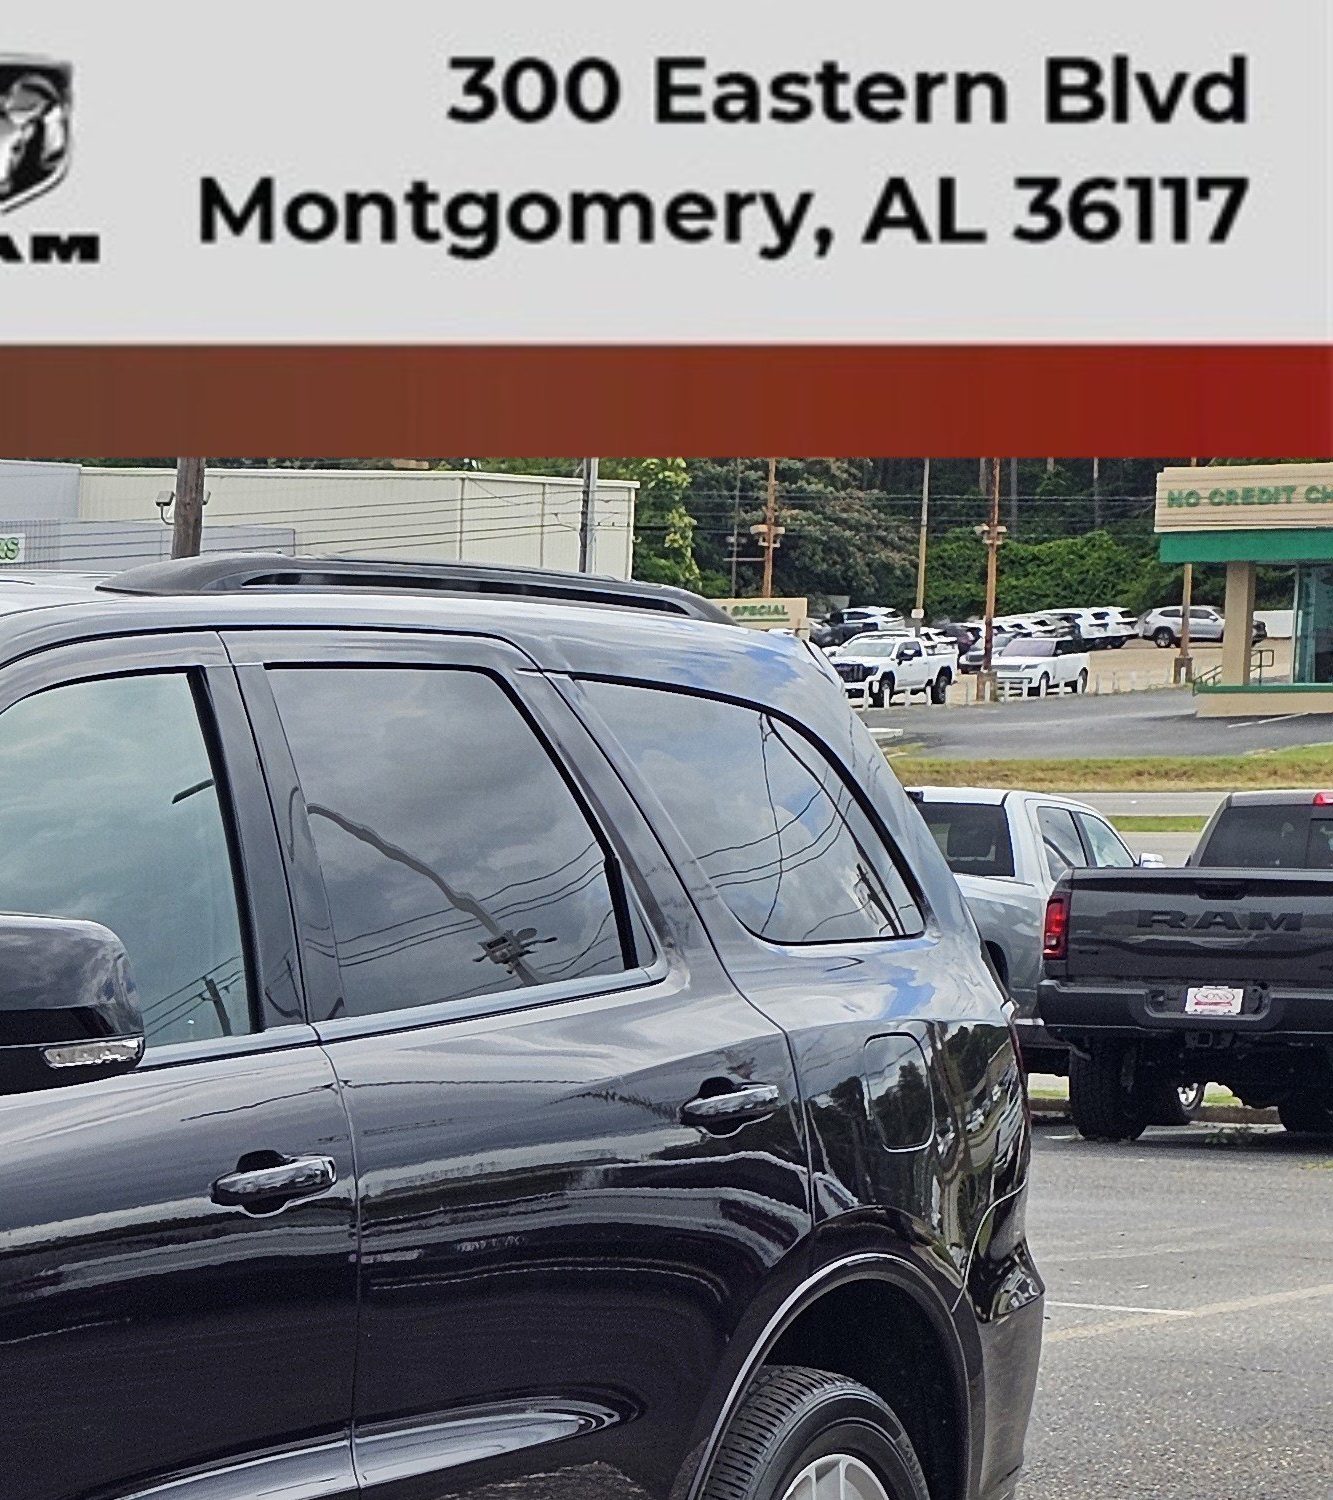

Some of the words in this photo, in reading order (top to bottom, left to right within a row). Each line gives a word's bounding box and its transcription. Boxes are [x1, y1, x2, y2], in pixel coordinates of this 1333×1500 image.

[1167, 489, 1201, 508] NO
[1208, 485, 1297, 506] CREDIT
[1137, 910, 1304, 932] RAM
